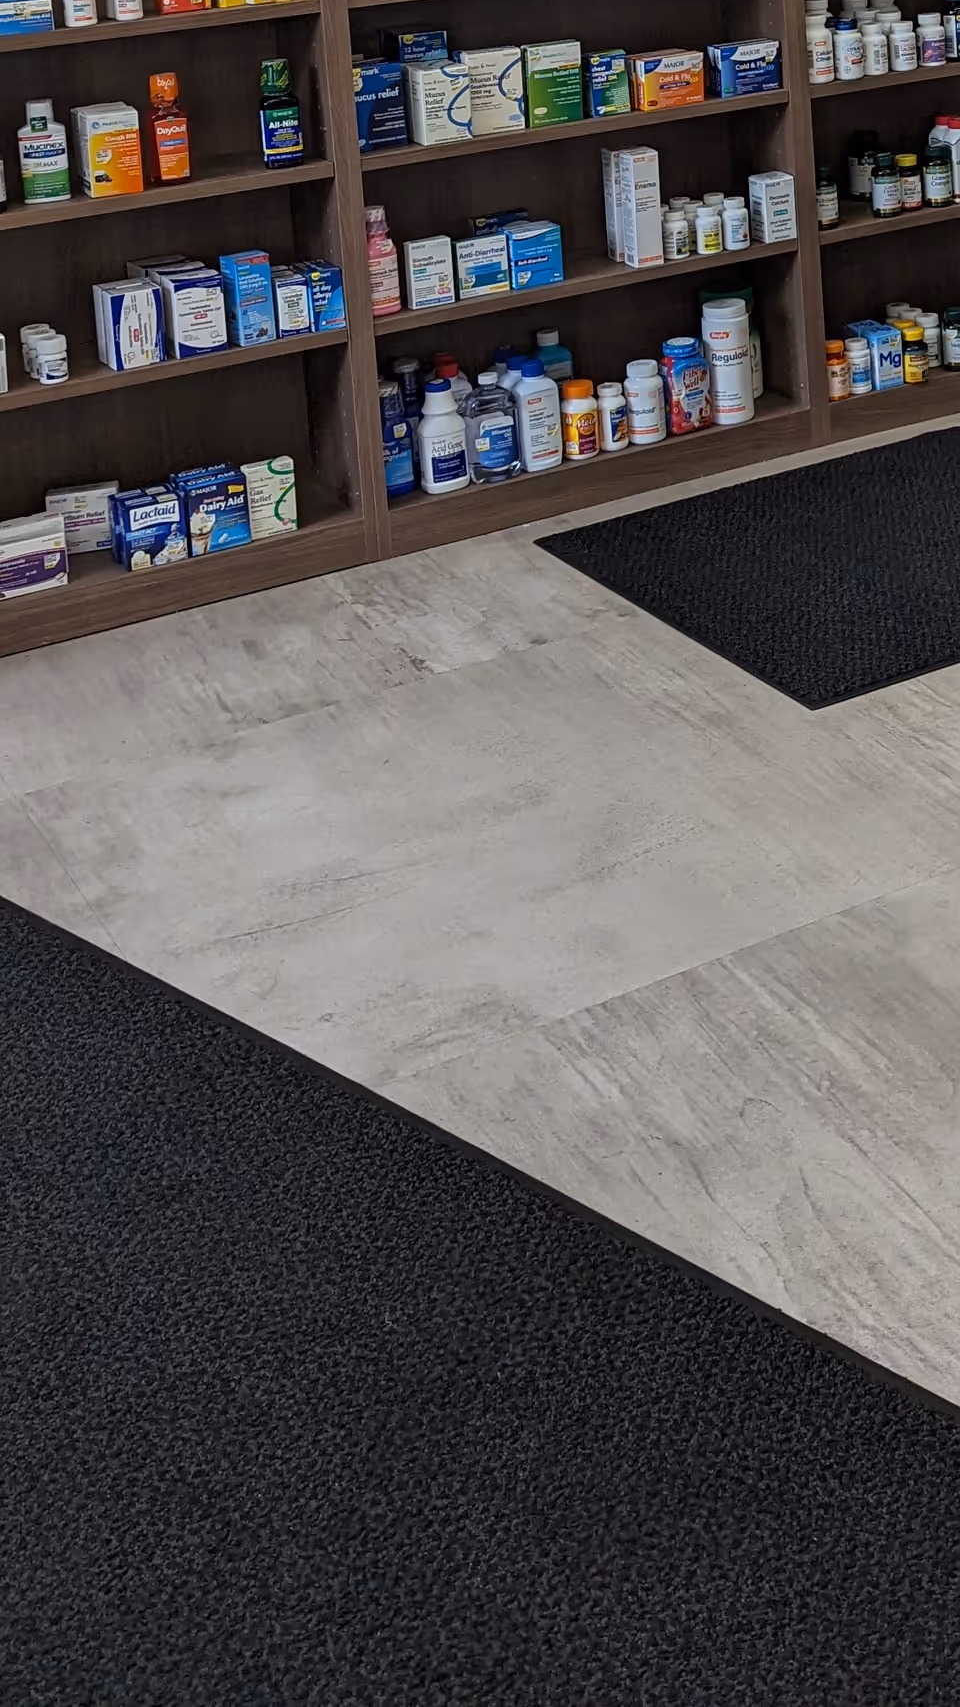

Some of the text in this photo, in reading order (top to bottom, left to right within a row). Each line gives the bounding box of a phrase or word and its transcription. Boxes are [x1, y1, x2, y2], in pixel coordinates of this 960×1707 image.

[740, 48, 761, 57] MAJOR
[664, 61, 685, 69] MAJOR
[735, 62, 750, 71] Cold
[470, 73, 511, 84] Mucus Relief
[659, 74, 674, 82] Cold
[378, 90, 399, 100] relief
[156, 125, 187, 136] DayQuil
[105, 135, 123, 143] Cough
[23, 140, 64, 151] Mucinex
[635, 181, 657, 191] Enema
[459, 245, 506, 260] Anti-Diarrheal
[711, 346, 749, 364] Reguloid
[879, 350, 902, 368] Mg
[432, 446, 446, 454] Acid
[197, 485, 217, 494] MAJOR
[200, 495, 244, 513] Dairy Aid
[250, 494, 272, 504] Relief
[133, 504, 176, 521] Lactaid
